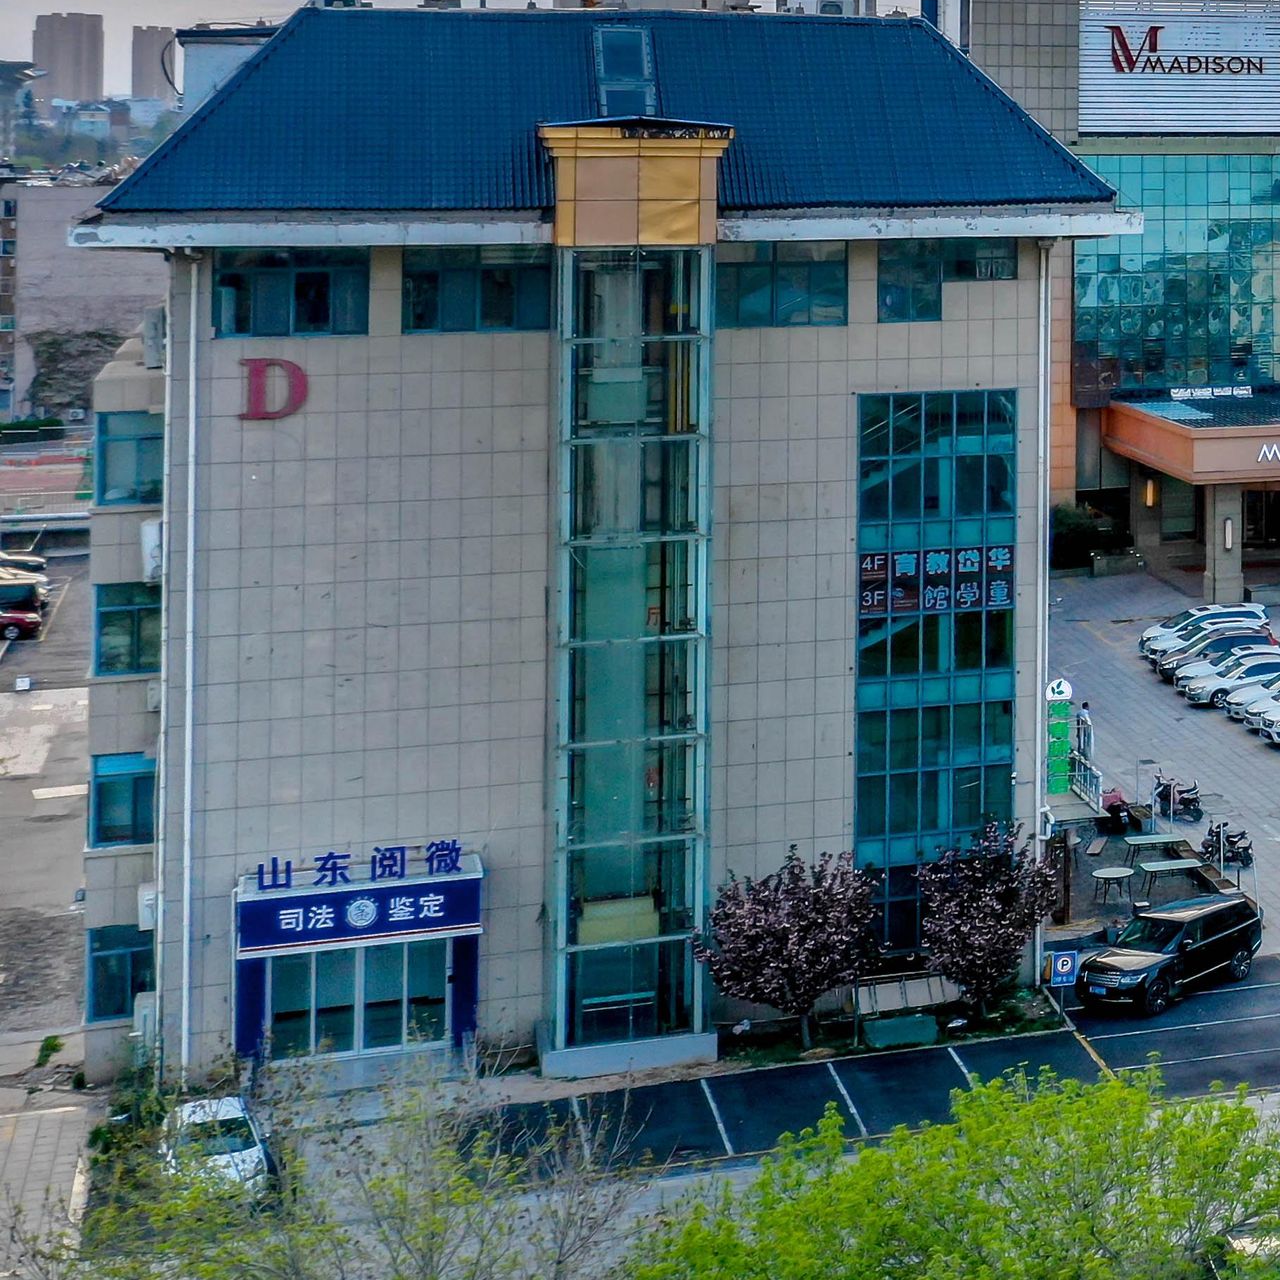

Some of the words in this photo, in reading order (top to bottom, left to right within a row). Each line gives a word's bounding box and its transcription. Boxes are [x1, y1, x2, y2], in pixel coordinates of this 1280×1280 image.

[1140, 55, 1264, 75] MADISON
[239, 357, 308, 421] D
[861, 555, 885, 571] 4F
[862, 590, 885, 607] 3F
[257, 839, 462, 891] 山东阅微
[278, 904, 335, 932] 司法
[388, 893, 445, 922] 鉴定
